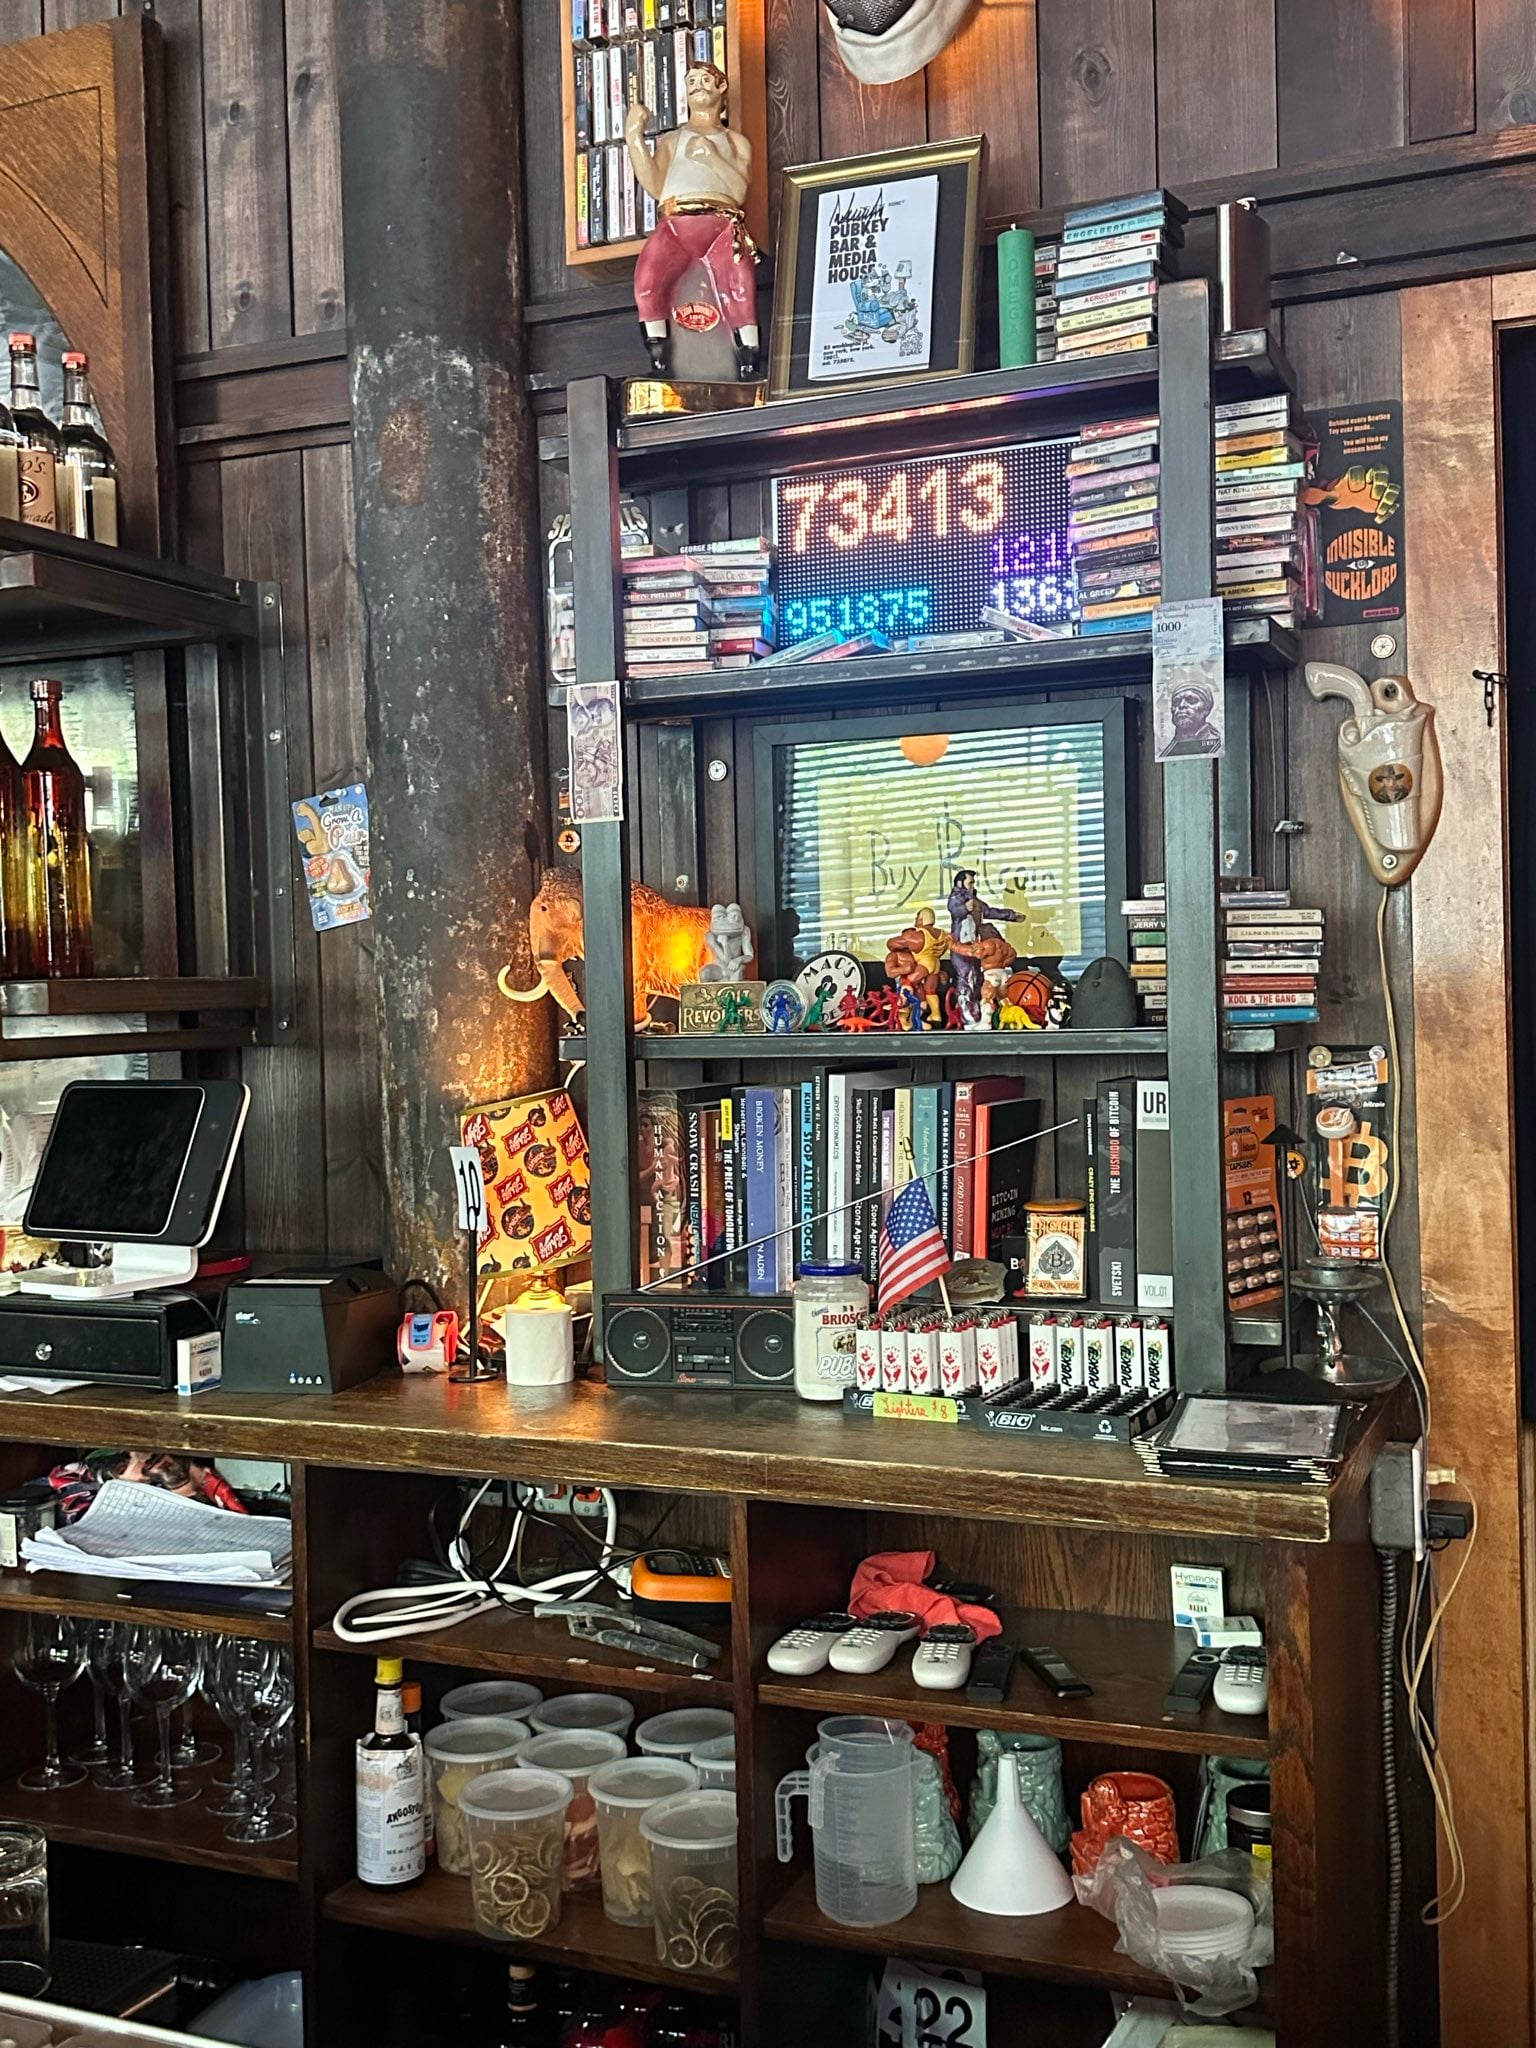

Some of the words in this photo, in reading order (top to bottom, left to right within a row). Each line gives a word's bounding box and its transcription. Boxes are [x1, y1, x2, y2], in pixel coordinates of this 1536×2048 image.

[830, 217, 889, 239] PUBKEY
[1066, 223, 1126, 240] ENGELBERT
[829, 237, 860, 254] BAR
[865, 235, 877, 249] &
[828, 249, 877, 269] MEDIA
[1007, 257, 1020, 337] OMEGA
[1084, 289, 1127, 303] AEROSMITH
[1340, 426, 1353, 434] ever
[1343, 439, 1354, 447] You
[1355, 437, 1366, 445] will
[1379, 435, 1389, 443] my
[1252, 484, 1271, 492] COLE
[782, 458, 1005, 555] 73413
[679, 544, 706, 555] GEORGE
[1327, 528, 1396, 564] INVISIBLE
[1228, 587, 1256, 595] AMERICA
[1325, 562, 1398, 601] SUCKLORD
[1079, 591, 1088, 600] AL
[1089, 587, 1116, 598] GREEN
[787, 586, 930, 636] 951875
[1157, 621, 1182, 633] 1000
[321, 814, 350, 830] Grow
[351, 809, 362, 823] A
[329, 825, 367, 849] Pair
[867, 830, 929, 908] Buy
[1133, 921, 1159, 929] JERRY
[802, 956, 857, 984] MAC'S
[1228, 994, 1248, 1004] KOOL
[1250, 995, 1256, 1004] &
[1259, 994, 1273, 1004] THE
[1274, 993, 1297, 1003] GANG
[1108, 1091, 1119, 1125] BITCOIN
[1143, 1091, 1167, 1114] UR
[755, 1100, 764, 1136] BROKEN
[688, 1111, 699, 1151] SNOW
[1109, 1126, 1120, 1138] OF
[652, 1124, 665, 1181] HUMAN
[723, 1149, 733, 1164] THE
[756, 1141, 765, 1174] MONEY
[803, 1131, 812, 1161] STOP
[1109, 1139, 1120, 1176] BUSHIDO
[689, 1153, 700, 1198] CRASH
[723, 1166, 734, 1190] PRICE
[804, 1163, 812, 1188] ALL
[956, 1175, 966, 1199] GOOD
[1110, 1177, 1121, 1195] THE
[724, 1191, 734, 1203] OF
[804, 1189, 812, 1209] THE
[1242, 1191, 1253, 1206] 12
[656, 1190, 667, 1257] ACTION
[854, 1202, 862, 1225] Stone
[870, 1204, 879, 1227] Stone
[991, 1205, 1016, 1223] MINING
[724, 1204, 734, 1251] TOMORROW
[854, 1226, 863, 1244] Age
[869, 1228, 879, 1243] Age
[1036, 1220, 1080, 1241] BICYCLE
[870, 1245, 879, 1281] Herbalist
[1331, 1247, 1361, 1257] PEZ
[756, 1255, 766, 1281] ALDEN
[1111, 1261, 1123, 1297] SVETSKI
[1060, 1345, 1072, 1387] PUBKEY
[1087, 1346, 1099, 1389] PUBKEY
[1120, 1345, 1132, 1388] PUBKEY
[1147, 1347, 1160, 1391] PUBKEY
[940, 1405, 948, 1419] 8
[998, 1415, 1030, 1427] BIC
[1040, 1423, 1064, 1433] bic.com
[1175, 1571, 1219, 1586] HYDRION
